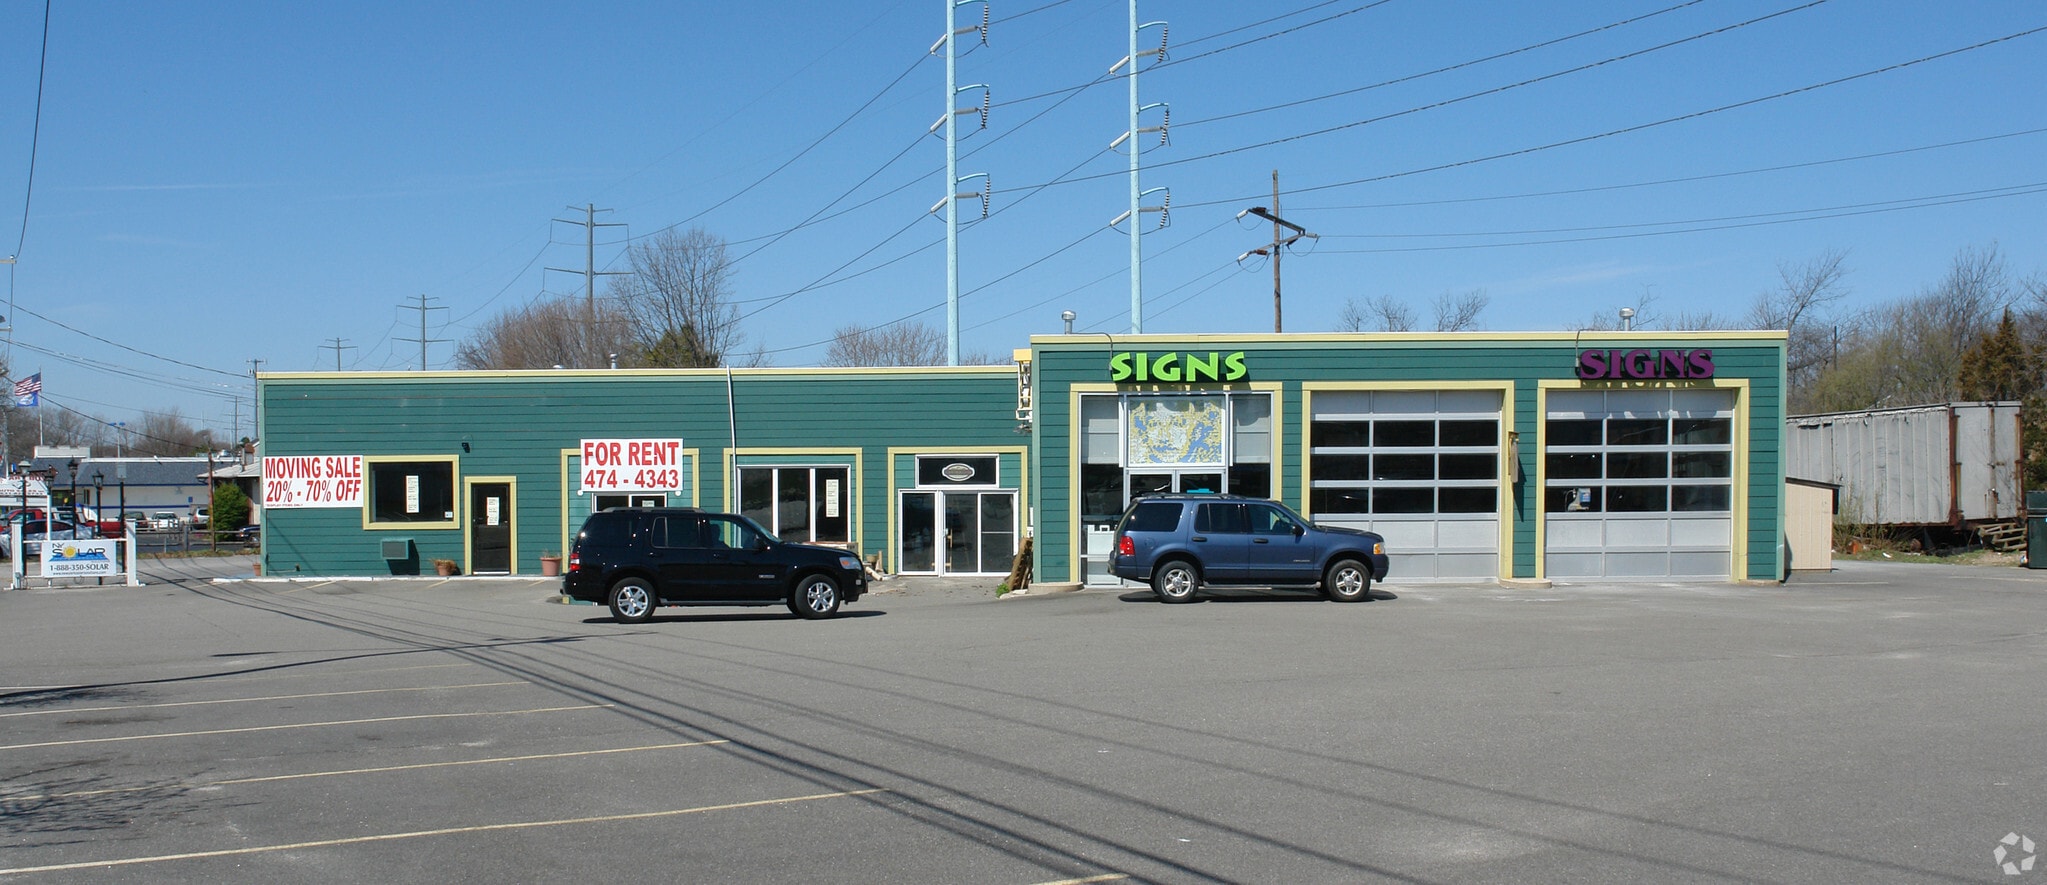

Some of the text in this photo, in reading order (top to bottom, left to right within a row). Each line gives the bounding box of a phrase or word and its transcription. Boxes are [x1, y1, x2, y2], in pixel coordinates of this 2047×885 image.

[1110, 351, 1247, 381] SIGNS
[1580, 348, 1715, 379] SIGNS
[584, 441, 680, 466] FOR RENT
[265, 456, 361, 479] MOVING SALE
[584, 469, 618, 488] 474
[634, 469, 679, 488] 4343
[266, 480, 293, 503] 20%
[305, 479, 332, 502] 70%
[335, 479, 361, 501] OFF
[50, 563, 109, 571] 1-888-350-SOLAR
